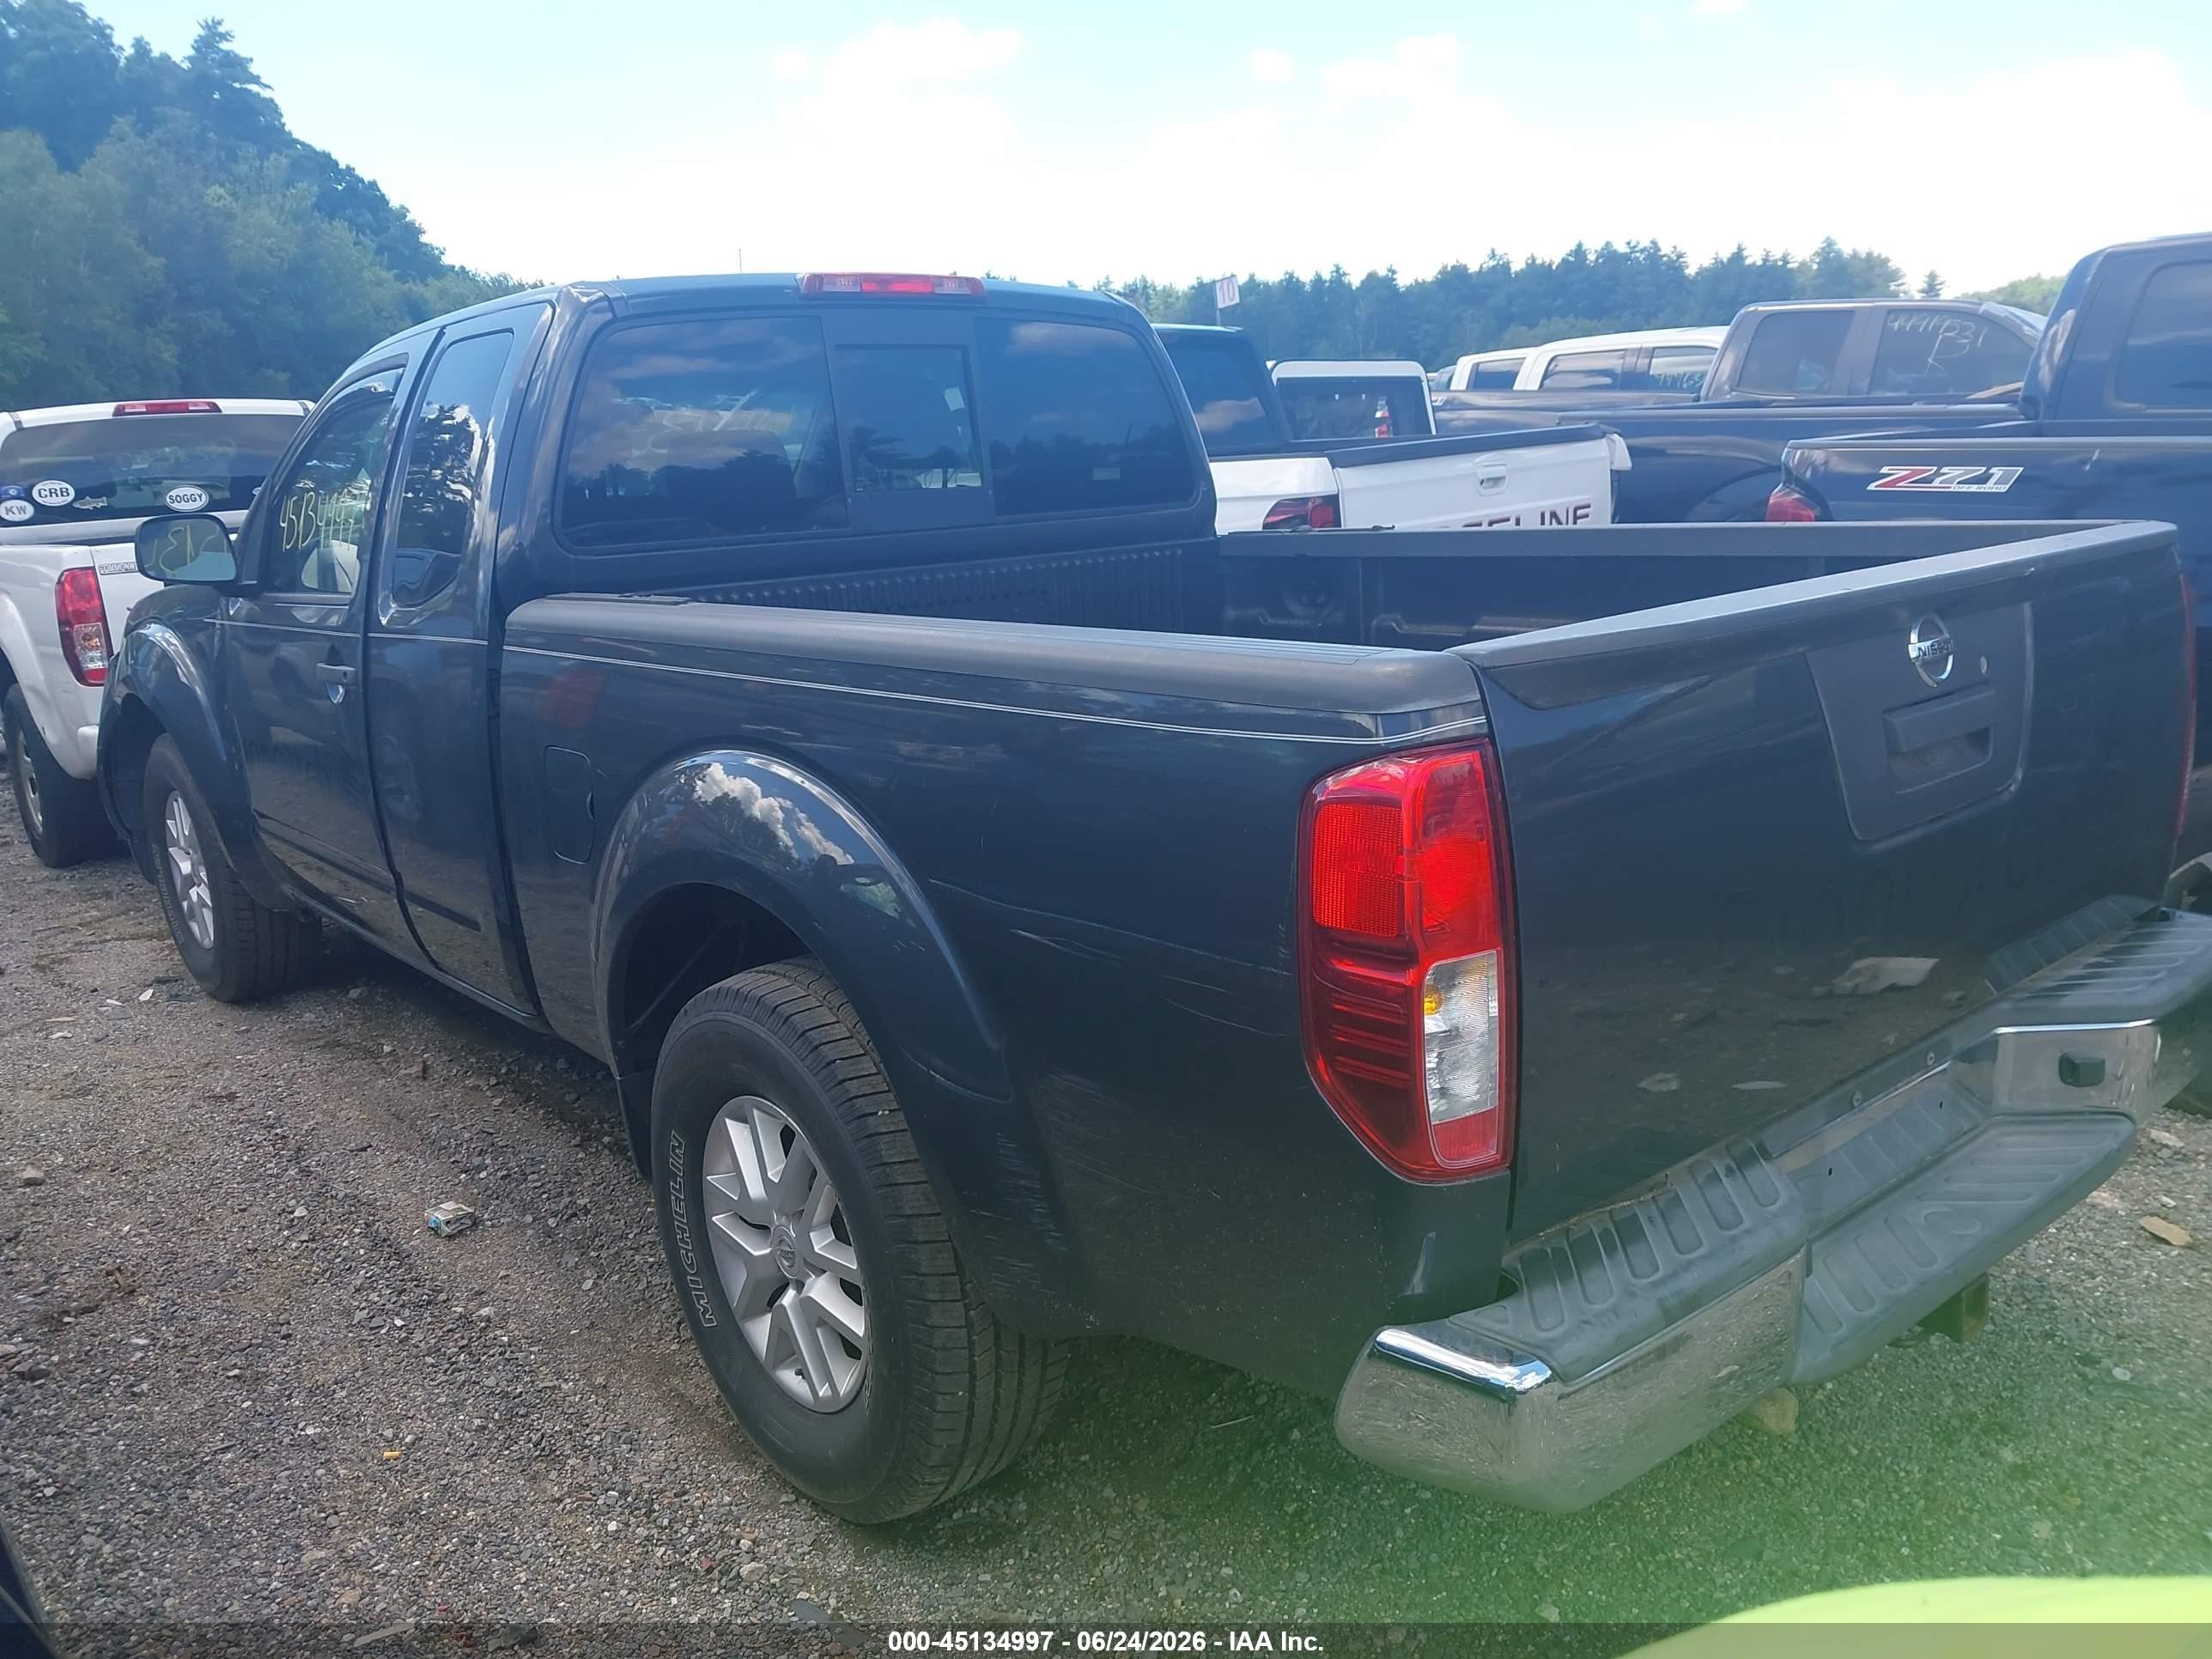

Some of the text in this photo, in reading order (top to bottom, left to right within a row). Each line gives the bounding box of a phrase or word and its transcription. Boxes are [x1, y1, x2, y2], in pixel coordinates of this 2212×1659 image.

[1218, 280, 1235, 304] 10
[1867, 466, 2024, 492] Z71
[37, 487, 70, 499] CRB
[167, 491, 204, 505] SOGGY
[4, 504, 27, 516] KW
[670, 1130, 718, 1328] MICHELIN
